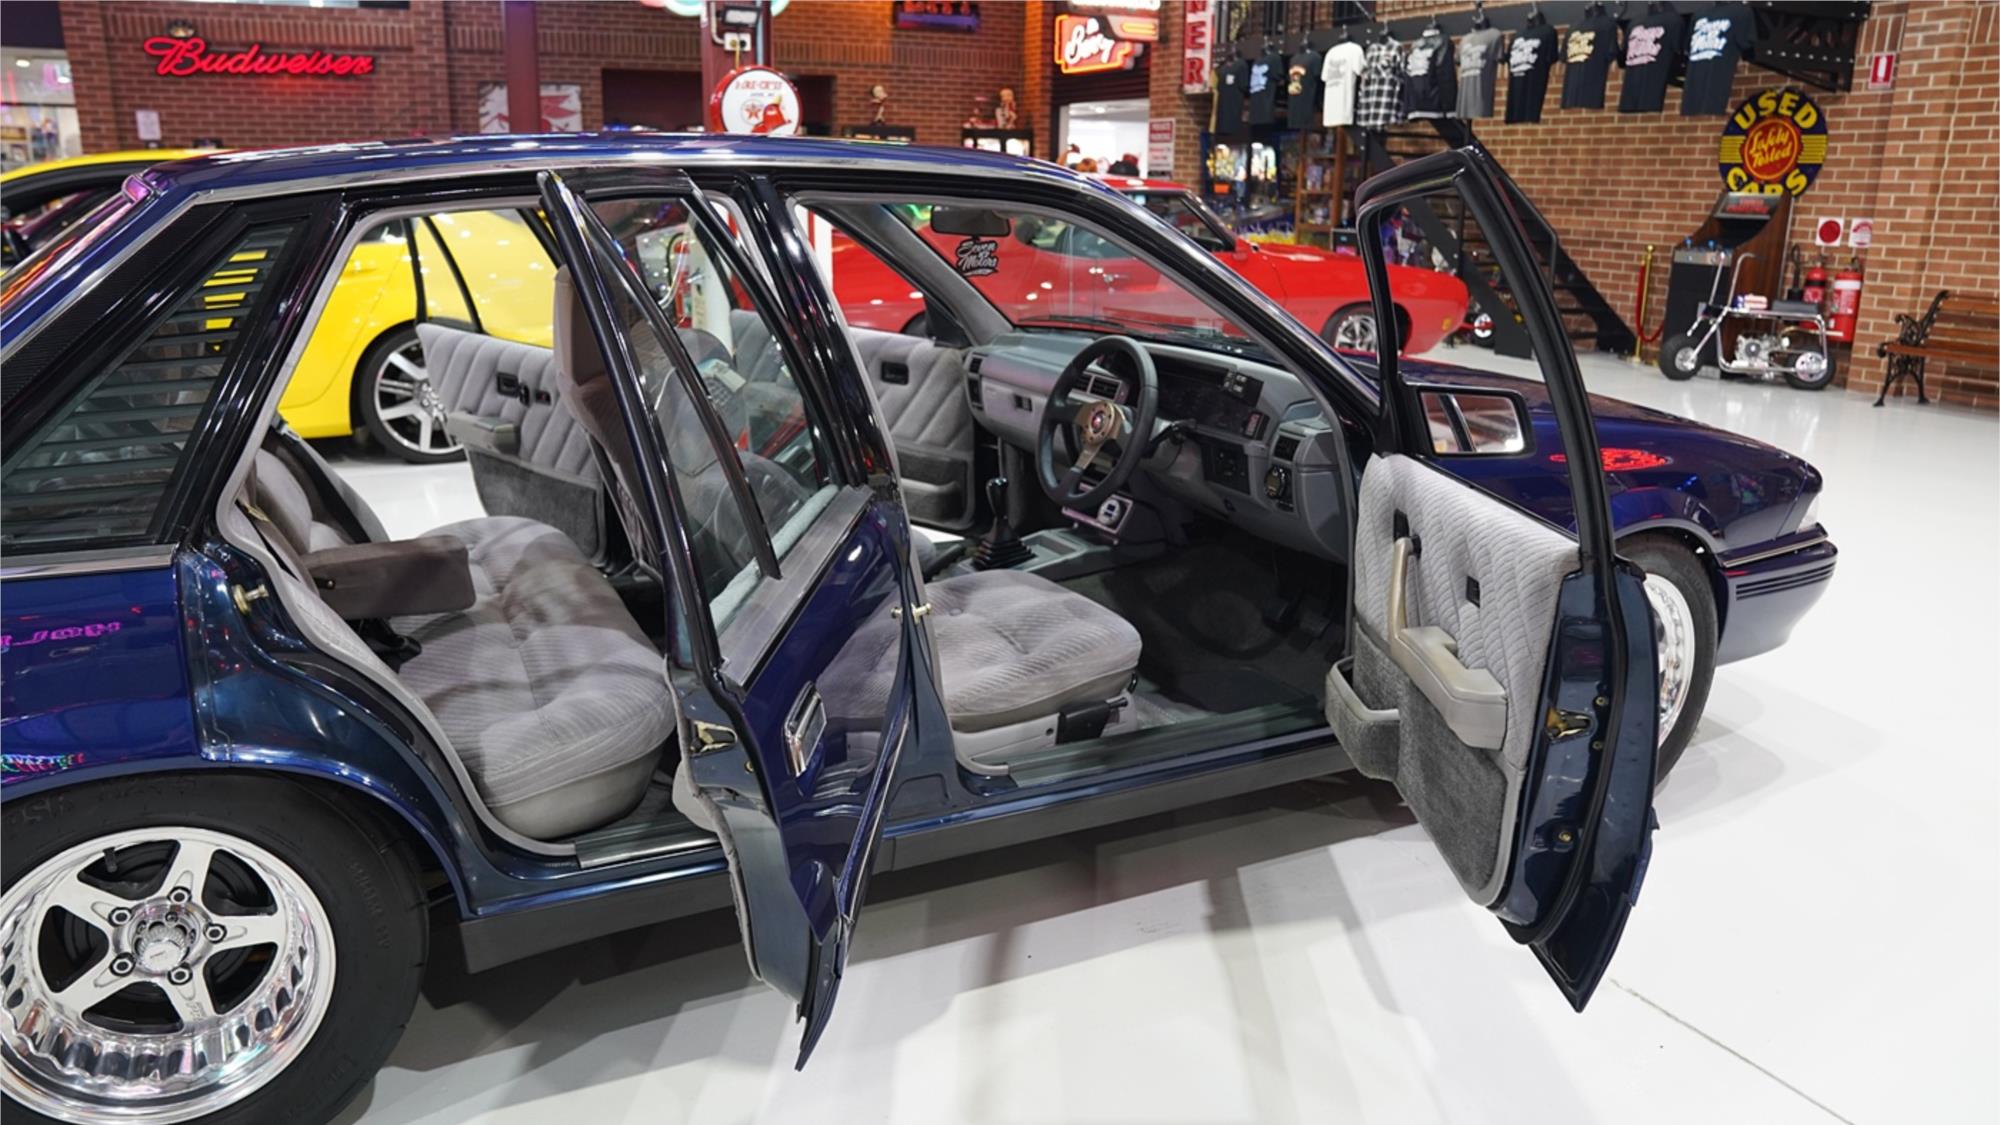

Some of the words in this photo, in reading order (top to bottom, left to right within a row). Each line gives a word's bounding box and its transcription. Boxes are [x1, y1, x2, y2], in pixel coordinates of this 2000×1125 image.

[144, 37, 373, 76] Budweiser
[1734, 90, 1818, 129] USED
[957, 240, 996, 258] Seven
[958, 255, 998, 272] Motors
